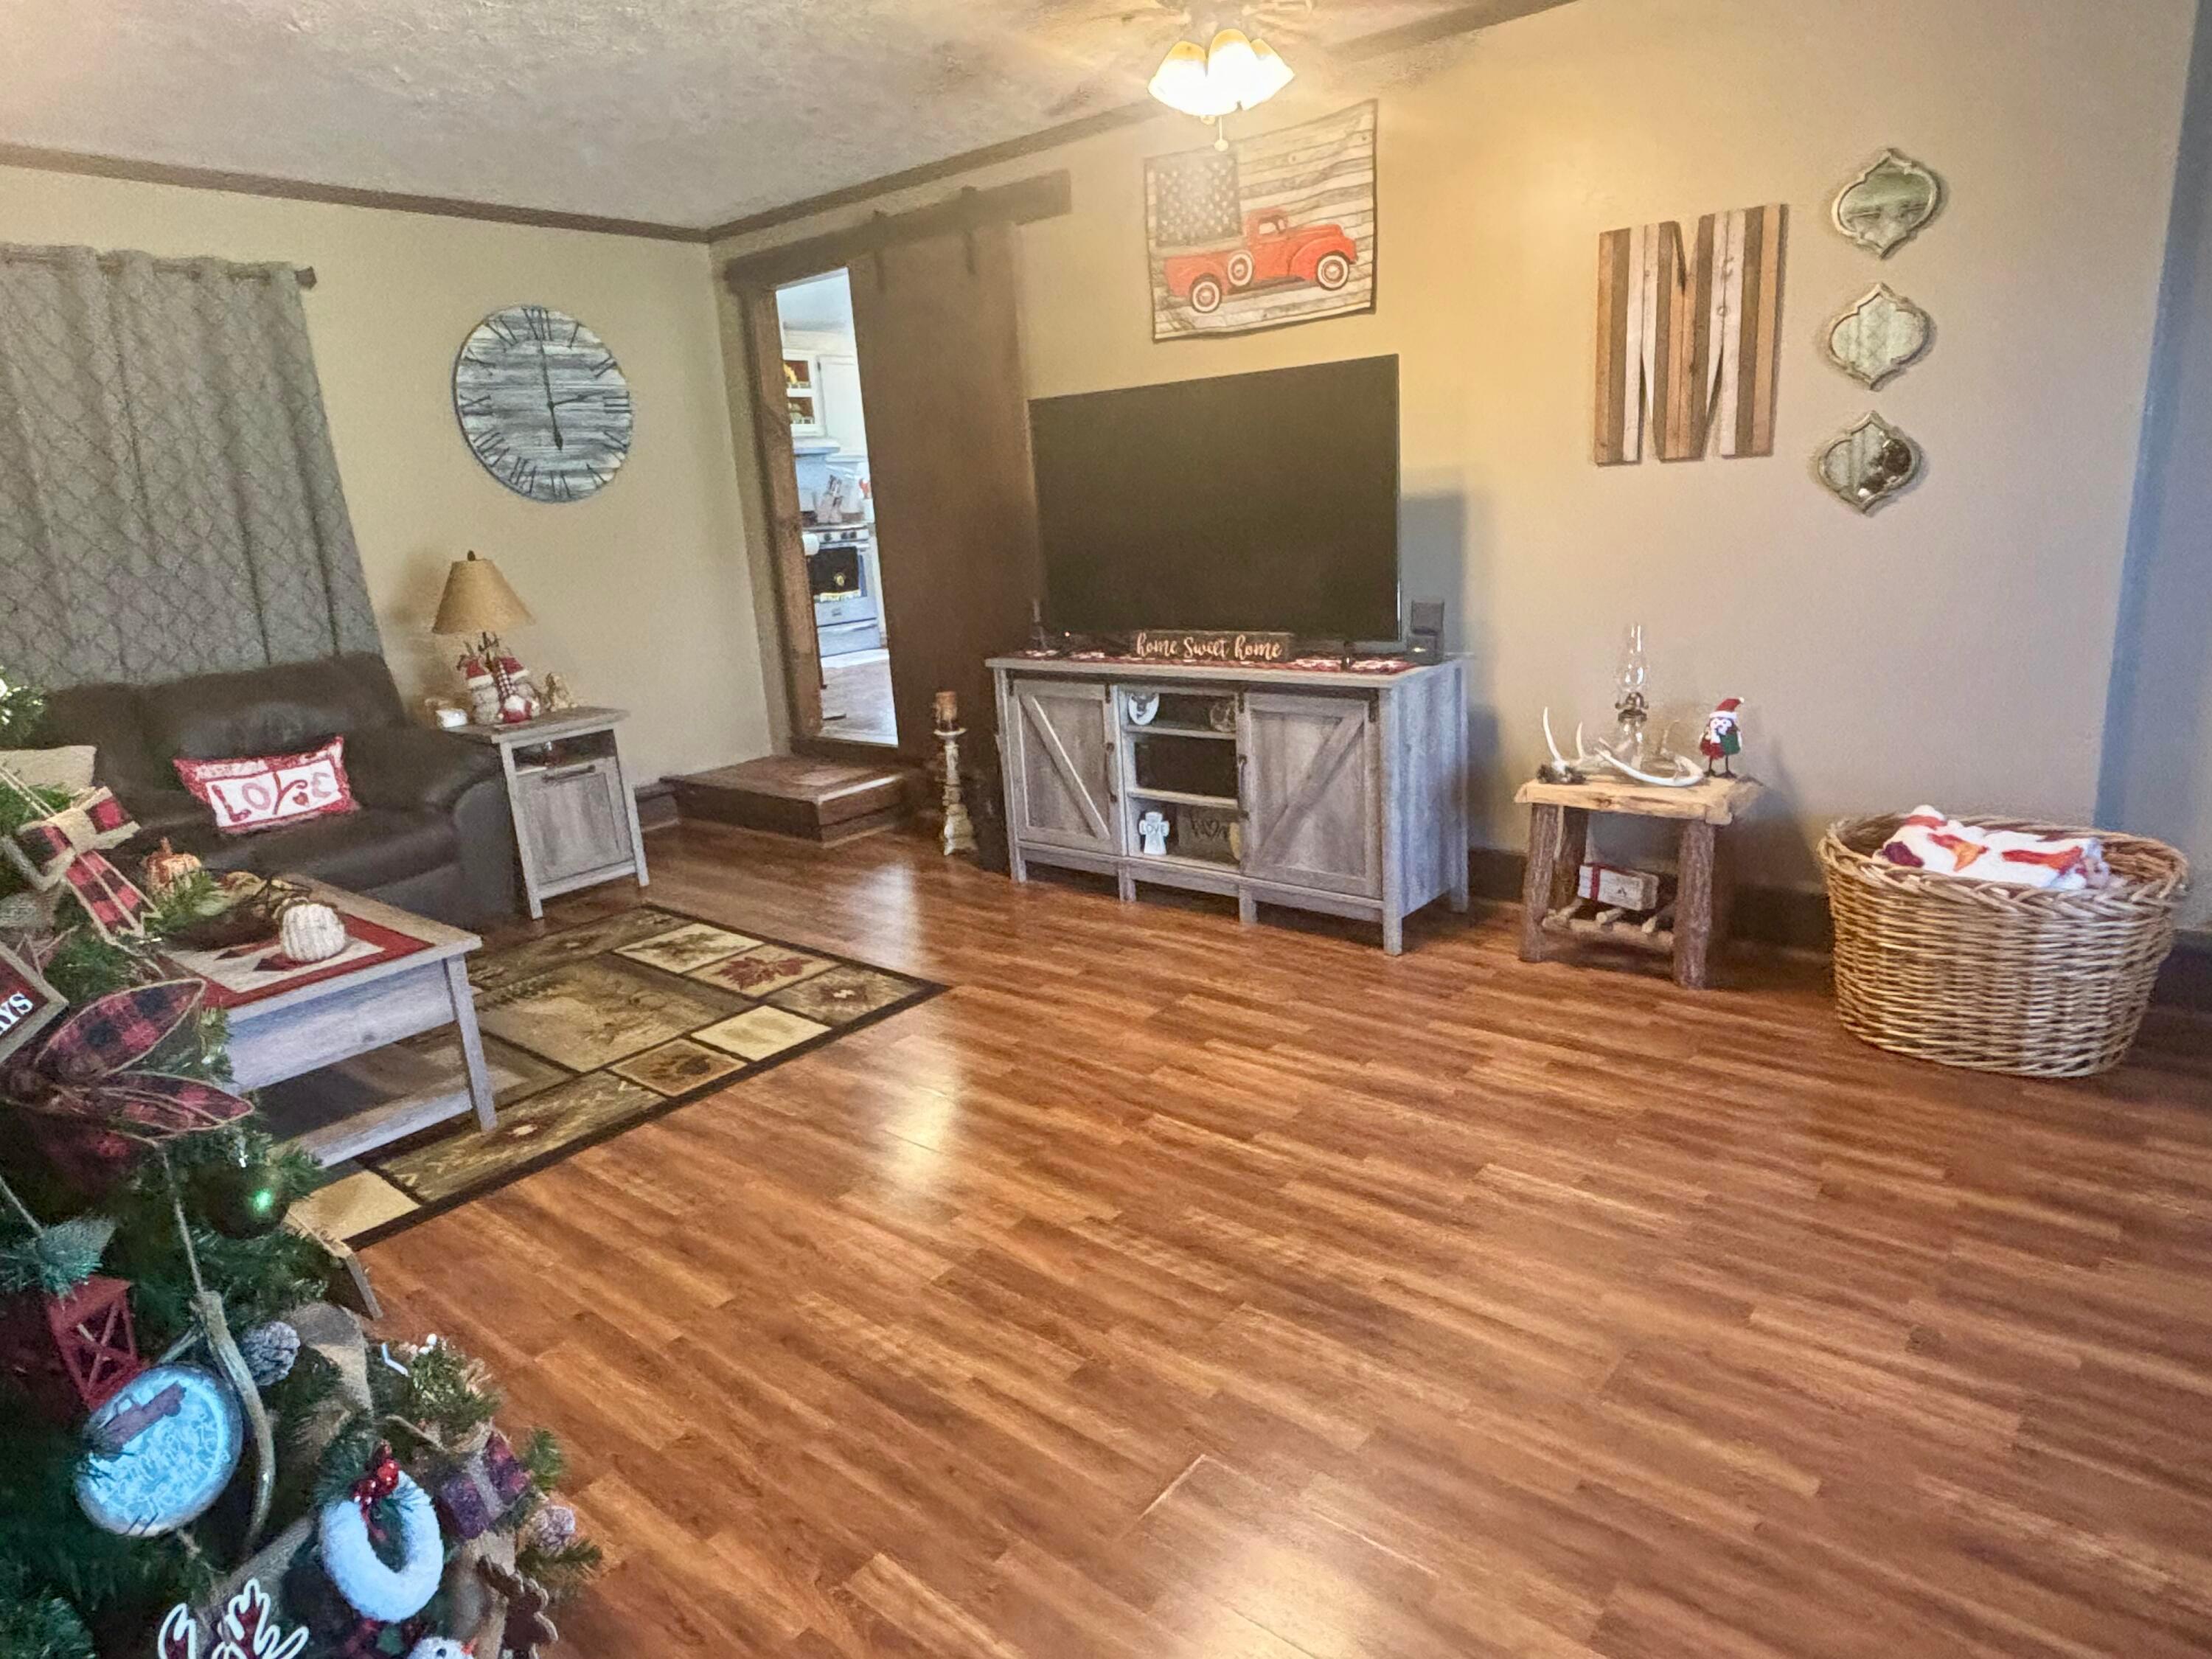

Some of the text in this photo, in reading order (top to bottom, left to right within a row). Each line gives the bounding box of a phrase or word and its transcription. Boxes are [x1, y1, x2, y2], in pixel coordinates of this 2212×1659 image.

[1183, 636, 1231, 660] Sweet
[211, 771, 332, 823] LOVE
[0, 992, 34, 1036] YS
